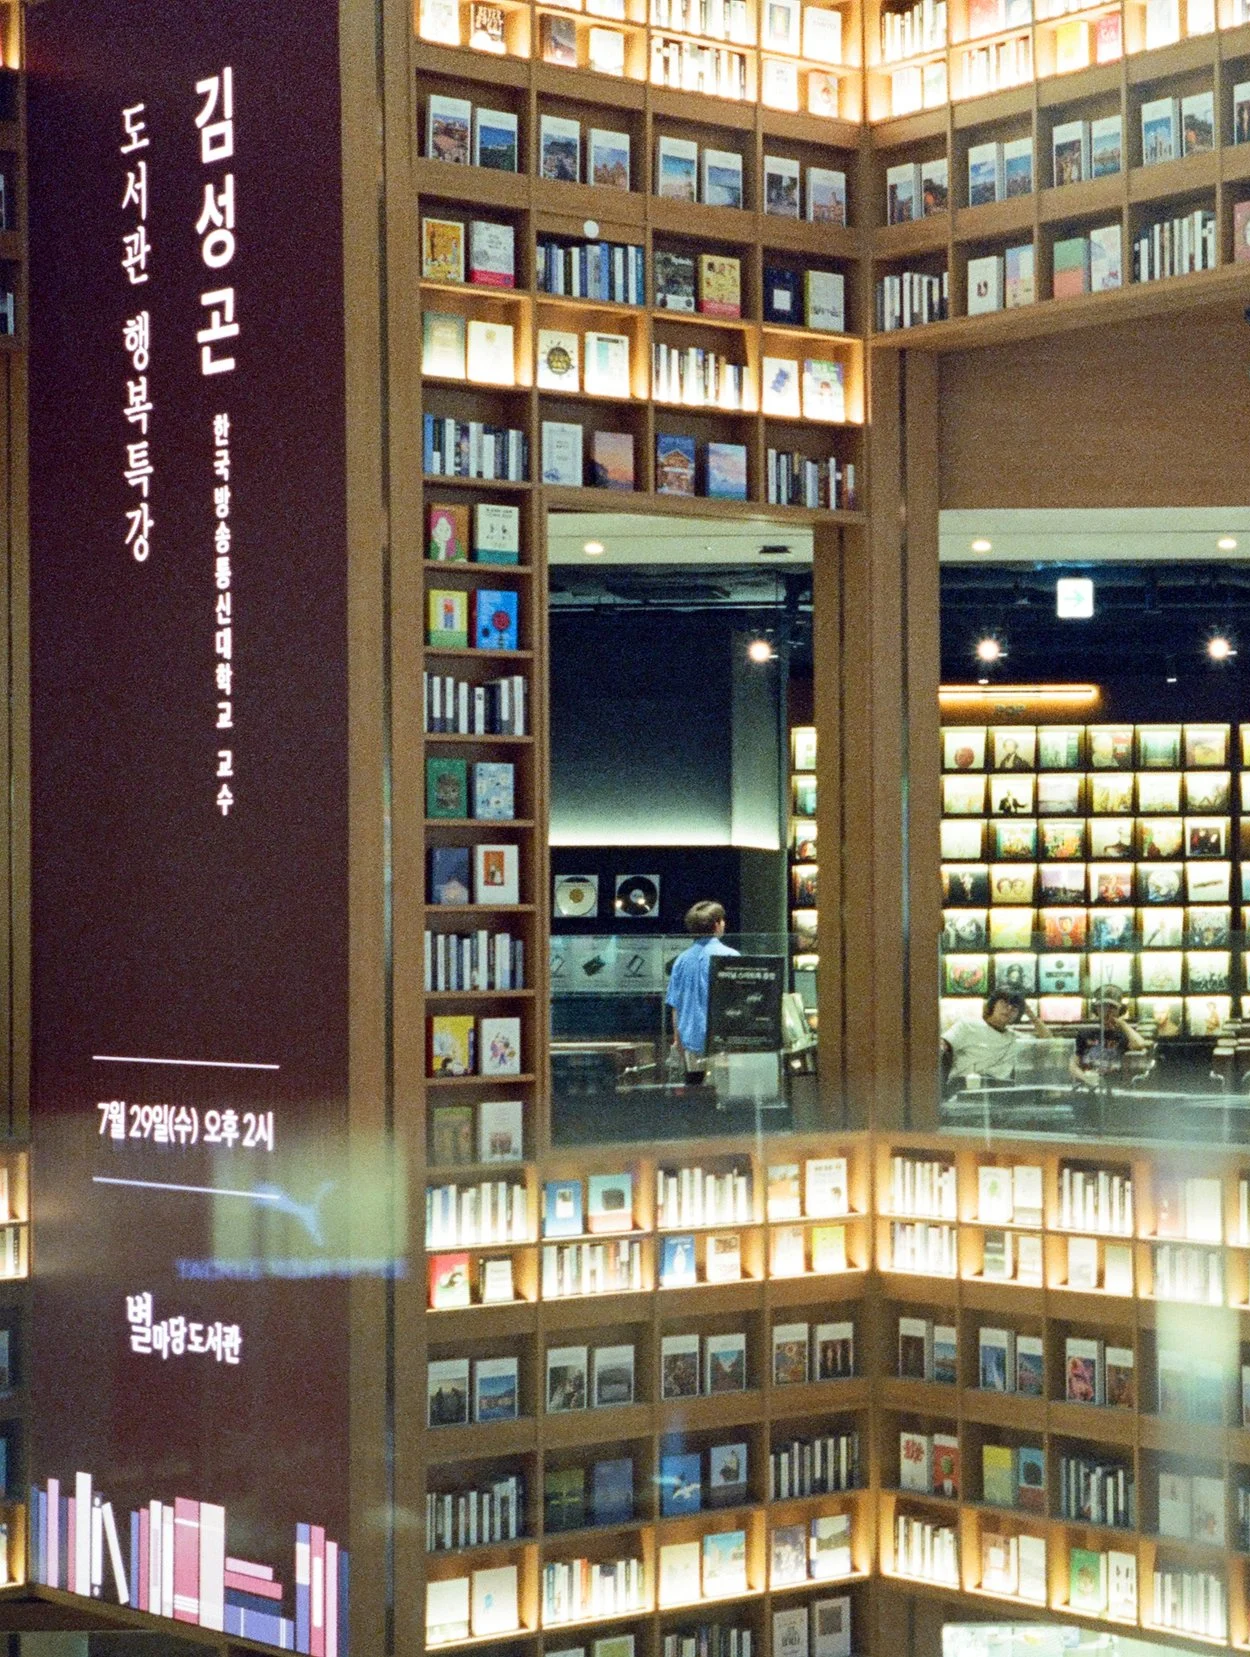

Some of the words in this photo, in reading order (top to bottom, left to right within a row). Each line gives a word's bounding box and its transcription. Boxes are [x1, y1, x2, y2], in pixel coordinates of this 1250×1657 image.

[120, 103, 152, 285] 도서관
[194, 66, 240, 376] 김성곤
[121, 310, 155, 562] 행복특강
[212, 412, 234, 729] 한국방송통신대학교
[215, 749, 234, 816] 교수
[97, 1100, 126, 1141] 7월
[128, 1104, 199, 1145] 29일(수)
[203, 1108, 240, 1149] 오후
[241, 1111, 275, 1152] 2시
